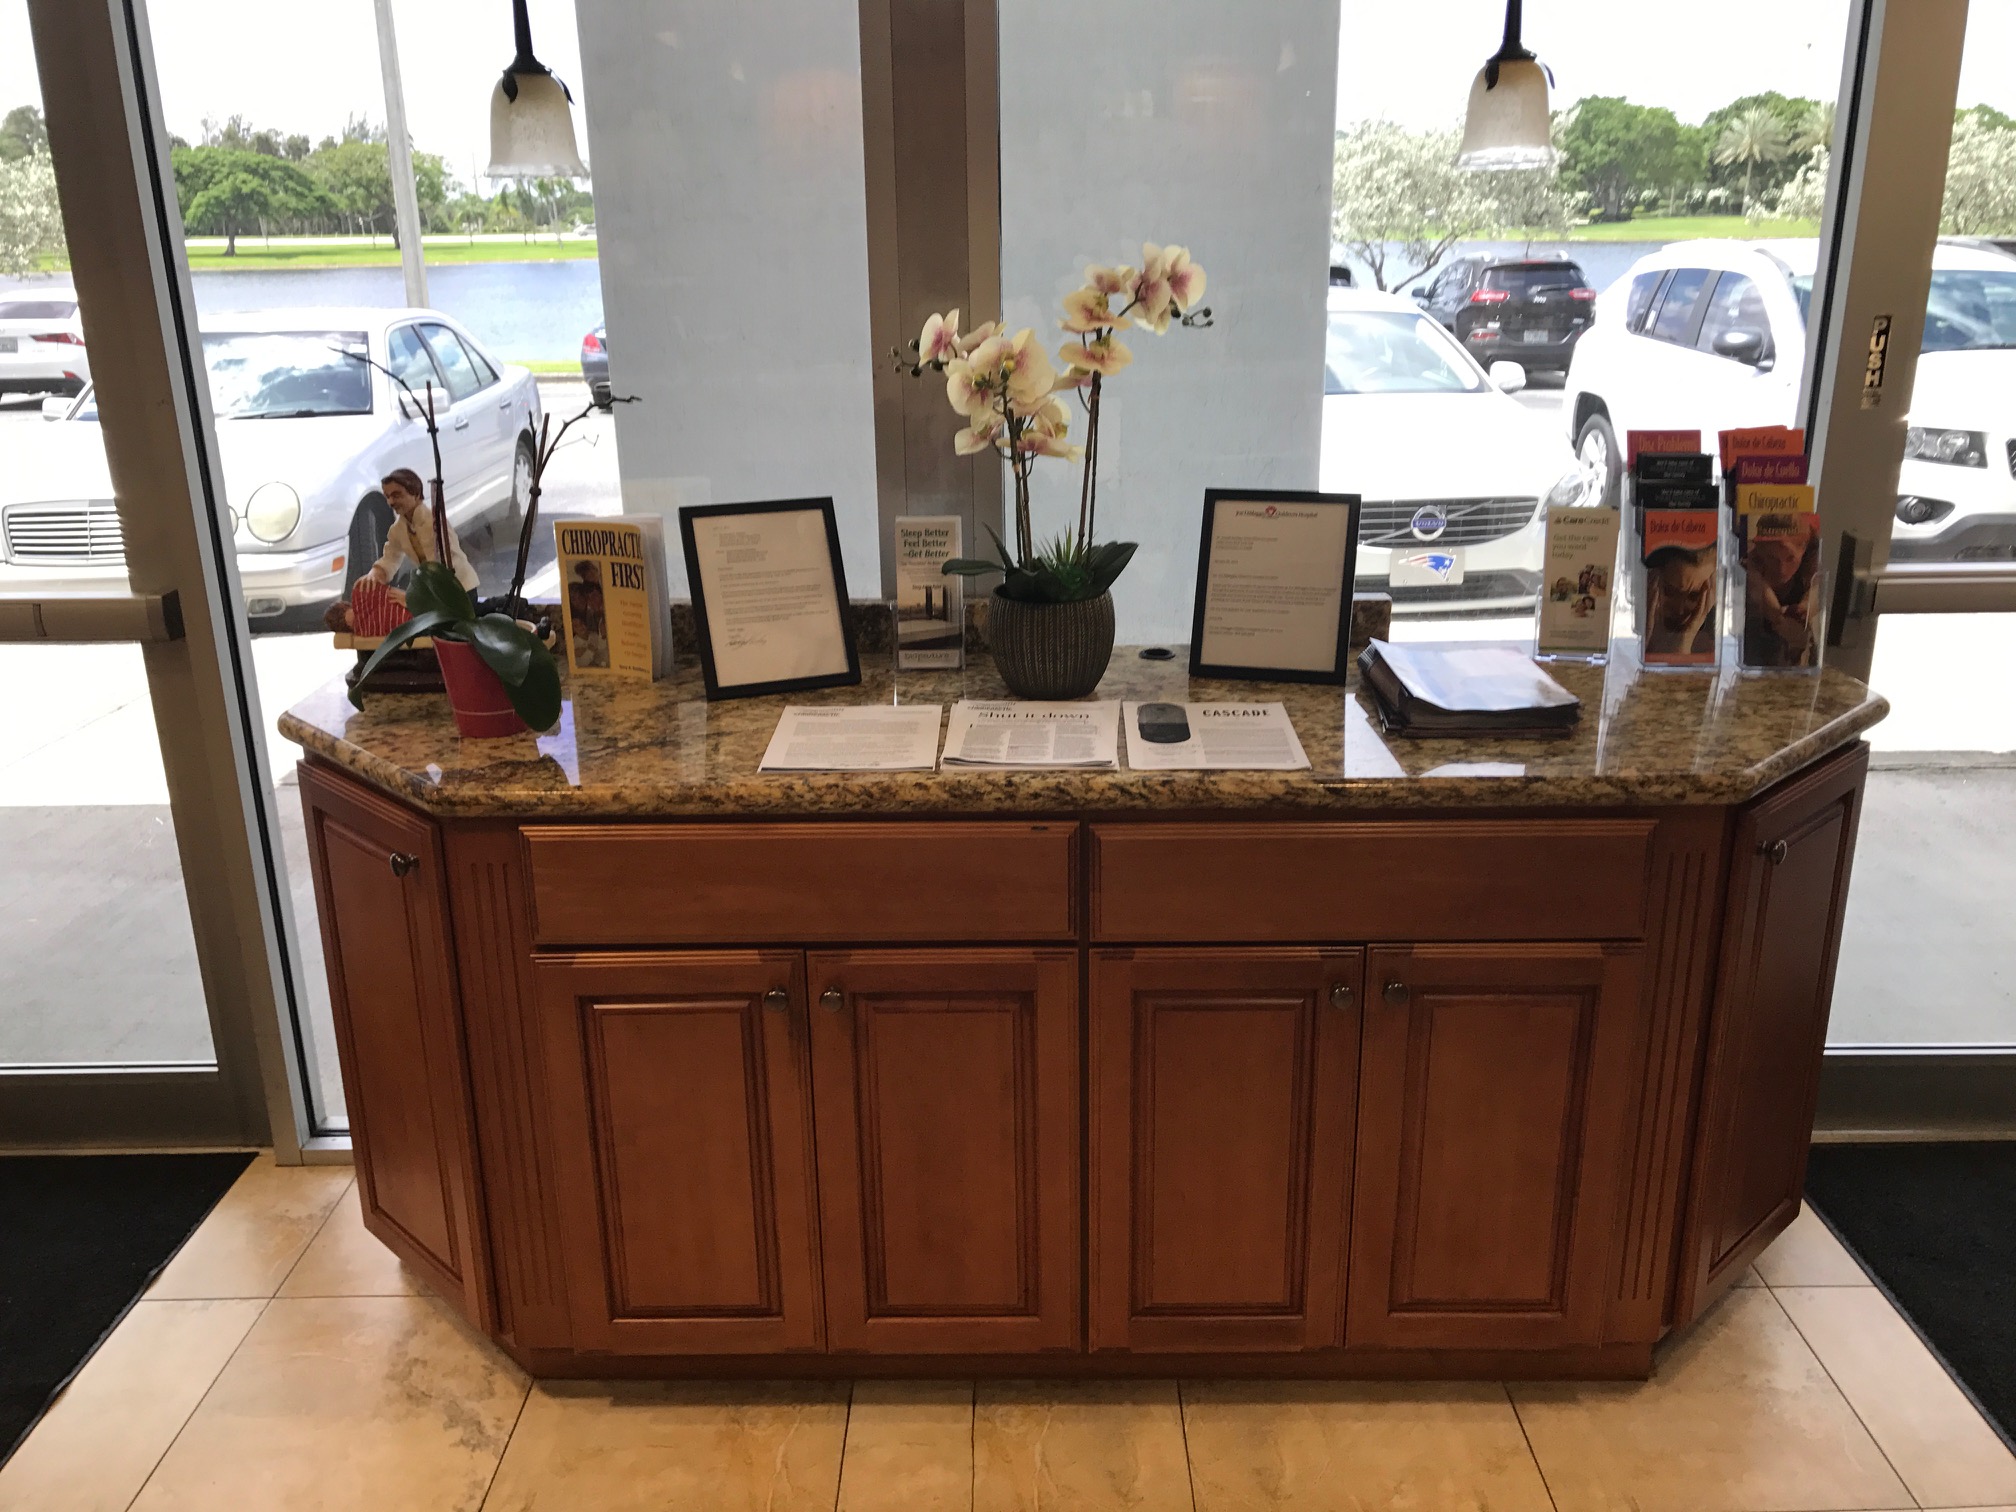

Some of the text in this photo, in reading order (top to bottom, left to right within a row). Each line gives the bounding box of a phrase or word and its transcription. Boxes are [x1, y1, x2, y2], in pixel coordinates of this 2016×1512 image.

[1864, 317, 1889, 388] PUSH
[1732, 435, 1751, 449] Dolor
[1752, 435, 1761, 448] de
[1742, 461, 1763, 478] Dolor
[1764, 460, 1775, 479] de
[1748, 492, 1799, 512] Chiropractic
[1650, 518, 1706, 534] Dolor de Cabeza
[901, 528, 949, 539] Sleep Better
[1568, 534, 1581, 542] the
[904, 539, 947, 548] Feel Better
[924, 549, 950, 558] Better
[610, 561, 645, 591] FIRST
[1202, 708, 1272, 718] CASCADE
